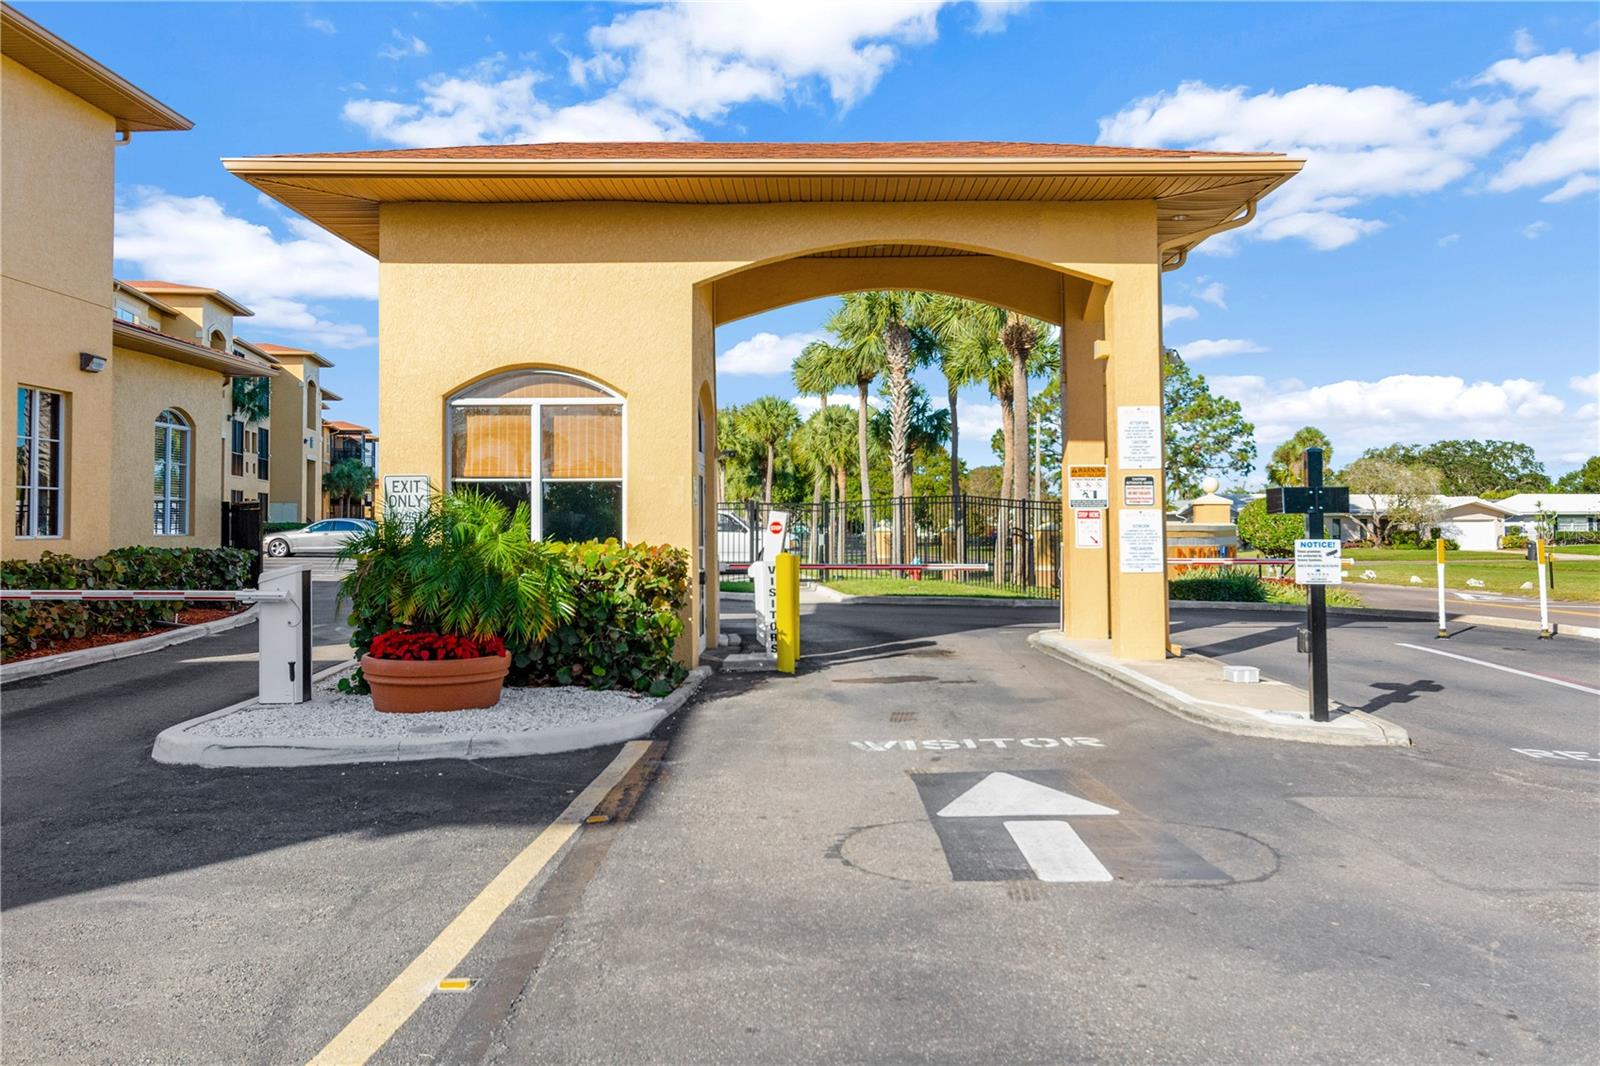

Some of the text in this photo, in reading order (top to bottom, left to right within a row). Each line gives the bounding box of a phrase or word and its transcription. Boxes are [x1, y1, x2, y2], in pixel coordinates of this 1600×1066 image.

[392, 480, 421, 493] EXIT
[389, 495, 424, 508] ONLY
[768, 566, 778, 653] VISITORS
[848, 736, 1109, 752] VISITOR
